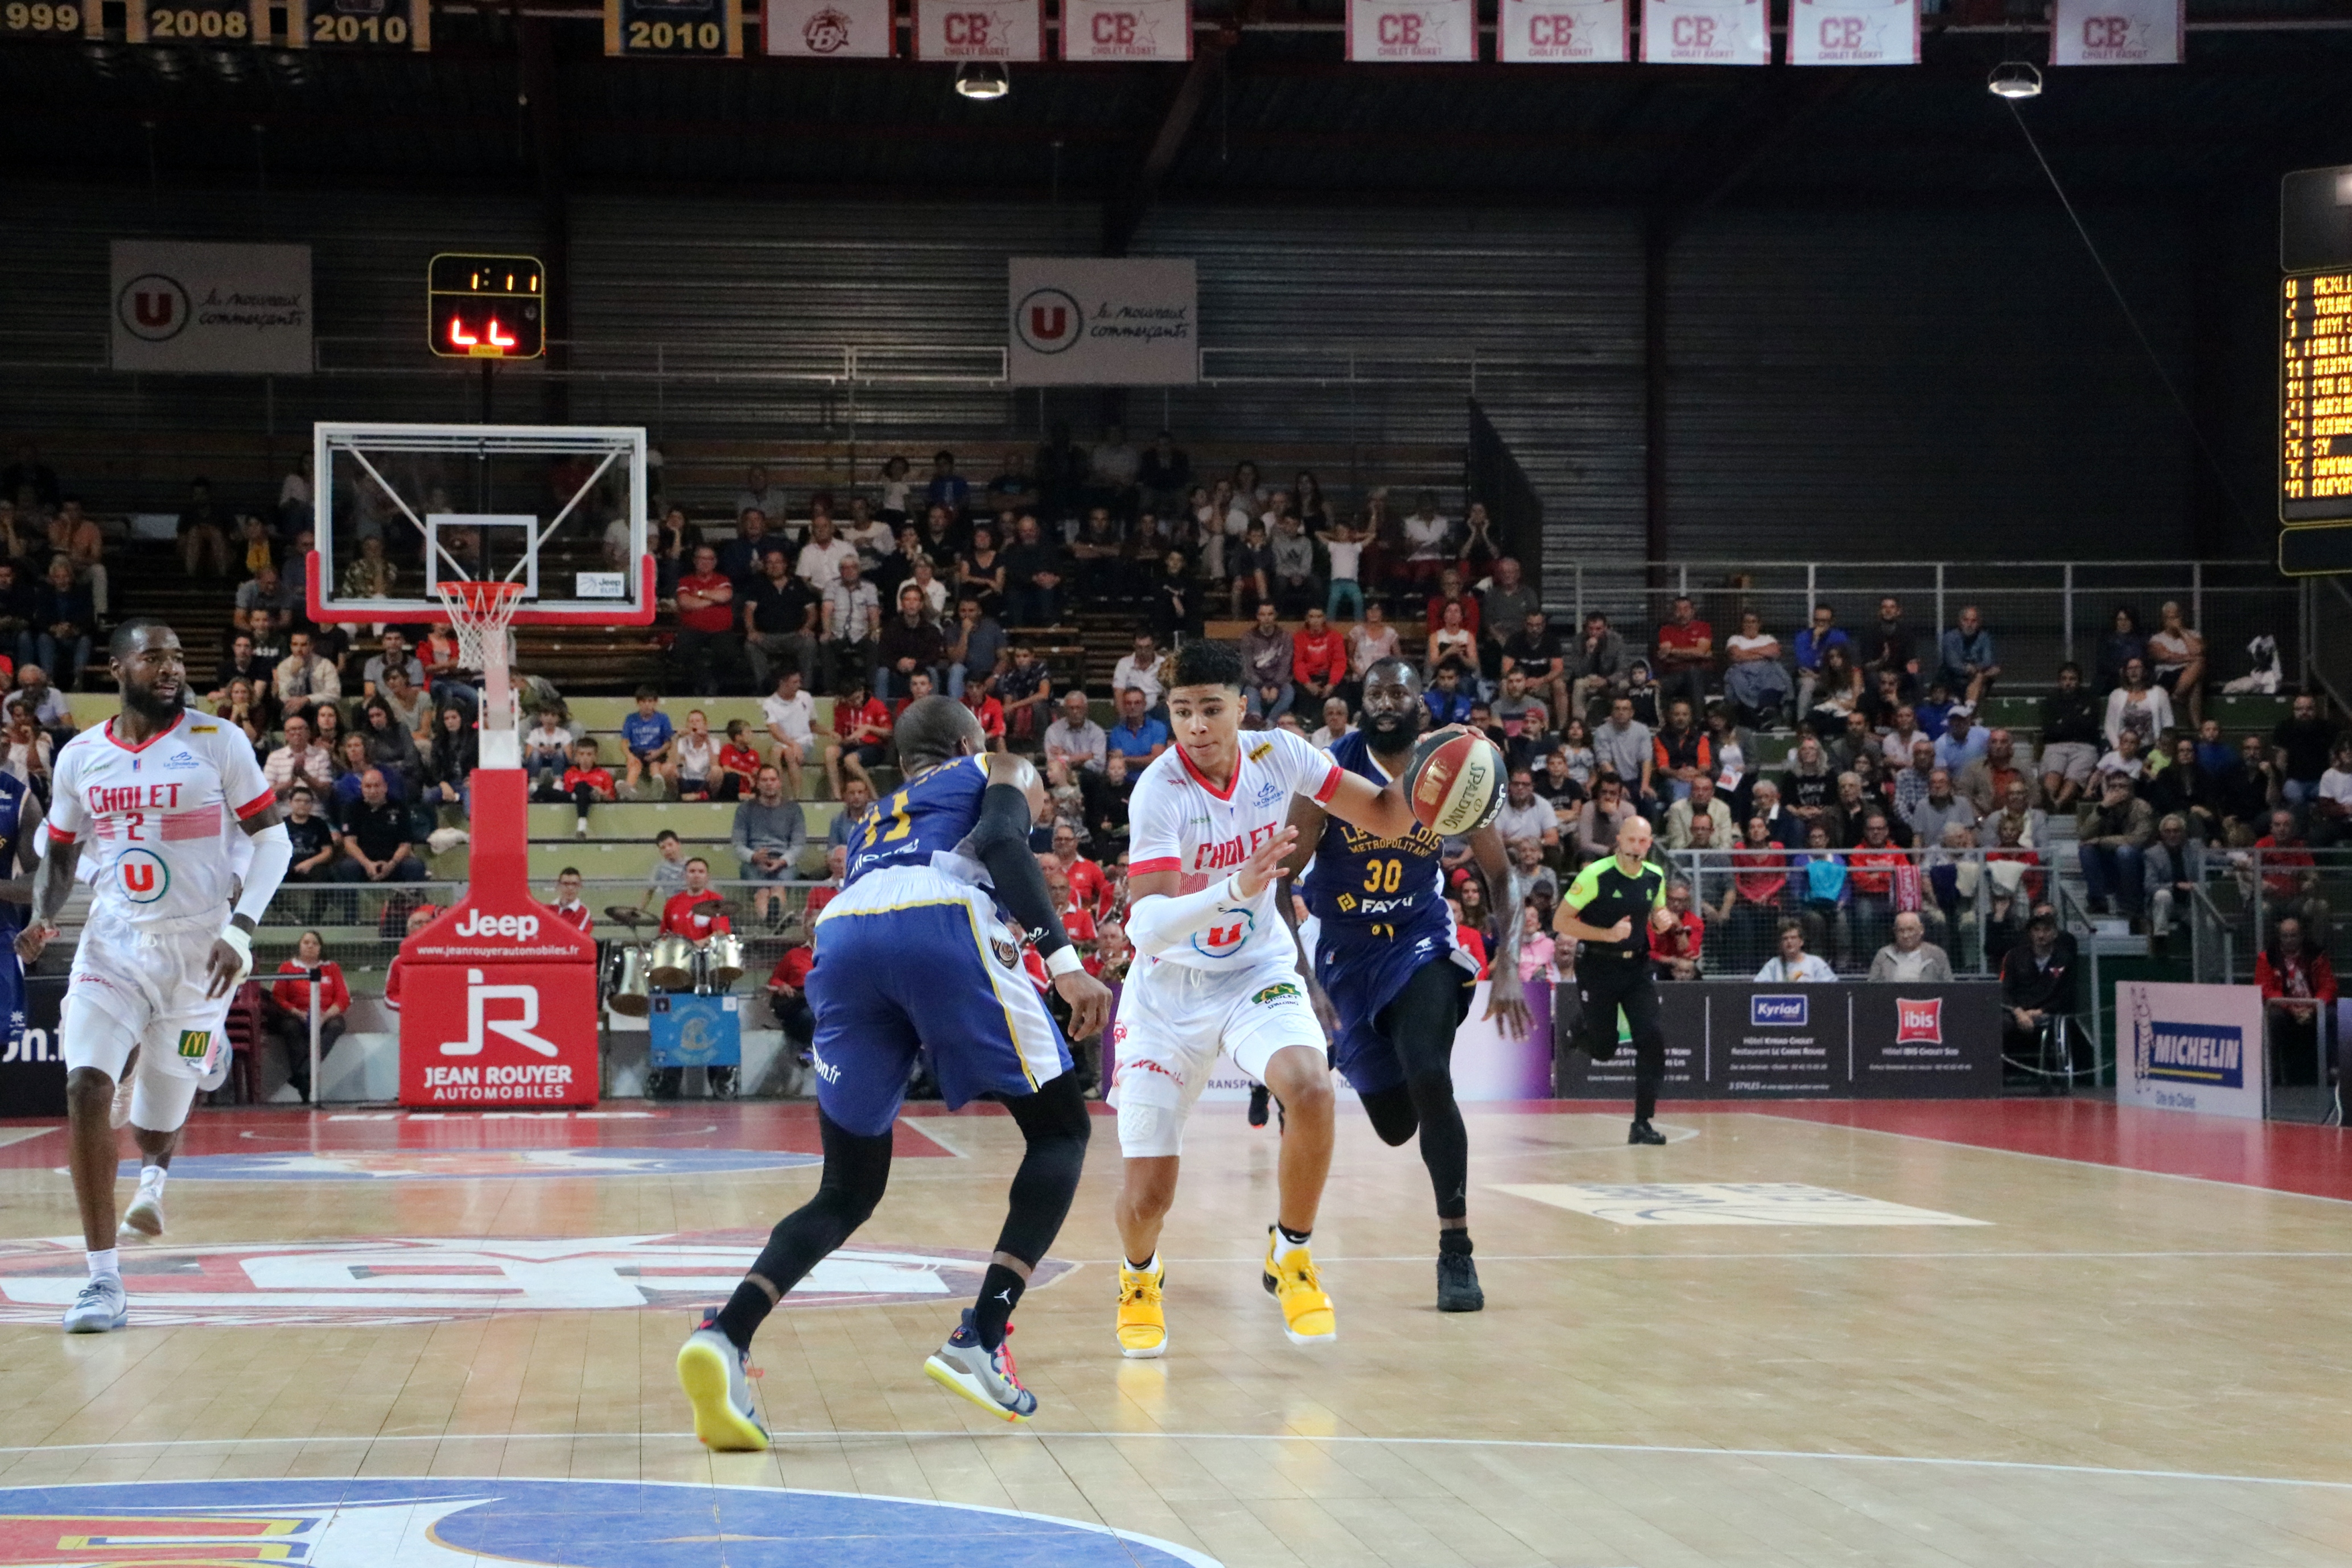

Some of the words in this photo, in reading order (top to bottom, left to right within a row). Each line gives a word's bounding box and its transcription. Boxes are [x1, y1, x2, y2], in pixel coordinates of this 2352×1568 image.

[152, 10, 247, 39] 2008
[313, 15, 407, 42] 2010
[629, 20, 720, 49] 2010
[944, 13, 989, 45] CB
[1092, 13, 1137, 44] CB
[1378, 14, 1422, 44] CB
[1530, 15, 1574, 46] CB
[1673, 16, 1716, 47] CB
[1819, 17, 1864, 48] CB
[2083, 16, 2129, 47] CB
[944, 47, 975, 56] CHOLET
[978, 47, 1010, 56] BASKET
[1091, 46, 1122, 55] CHOLET
[1125, 46, 1156, 55] BASKET
[1378, 47, 1408, 56] CHOLET
[1411, 47, 1441, 56] BASKET
[1562, 48, 1593, 57] BASKET
[135, 292, 172, 327] U
[1031, 306, 1065, 340] U
[2313, 437, 2332, 456] SY
[599, 578, 621, 588] Jeep
[89, 783, 183, 814] CHOLET
[1440, 762, 1485, 830] SPALDING
[1479, 783, 1506, 829] Jeep
[126, 812, 144, 841] 2
[1194, 821, 1277, 869] CHOLET
[124, 864, 154, 892] U
[1364, 858, 1402, 893] 30
[455, 908, 539, 942] Jeep
[1207, 918, 1245, 947] U
[417, 946, 579, 958] www.jeanrouyerautomobiles.fr
[1757, 1003, 1801, 1017] Kyriad
[1904, 1011, 1934, 1028] ibis
[2154, 1034, 2240, 1070] MICHELIN
[423, 1066, 480, 1088] JEAN
[485, 1064, 573, 1085] ROUYER
[433, 1085, 565, 1100] AUTOMOBILES
